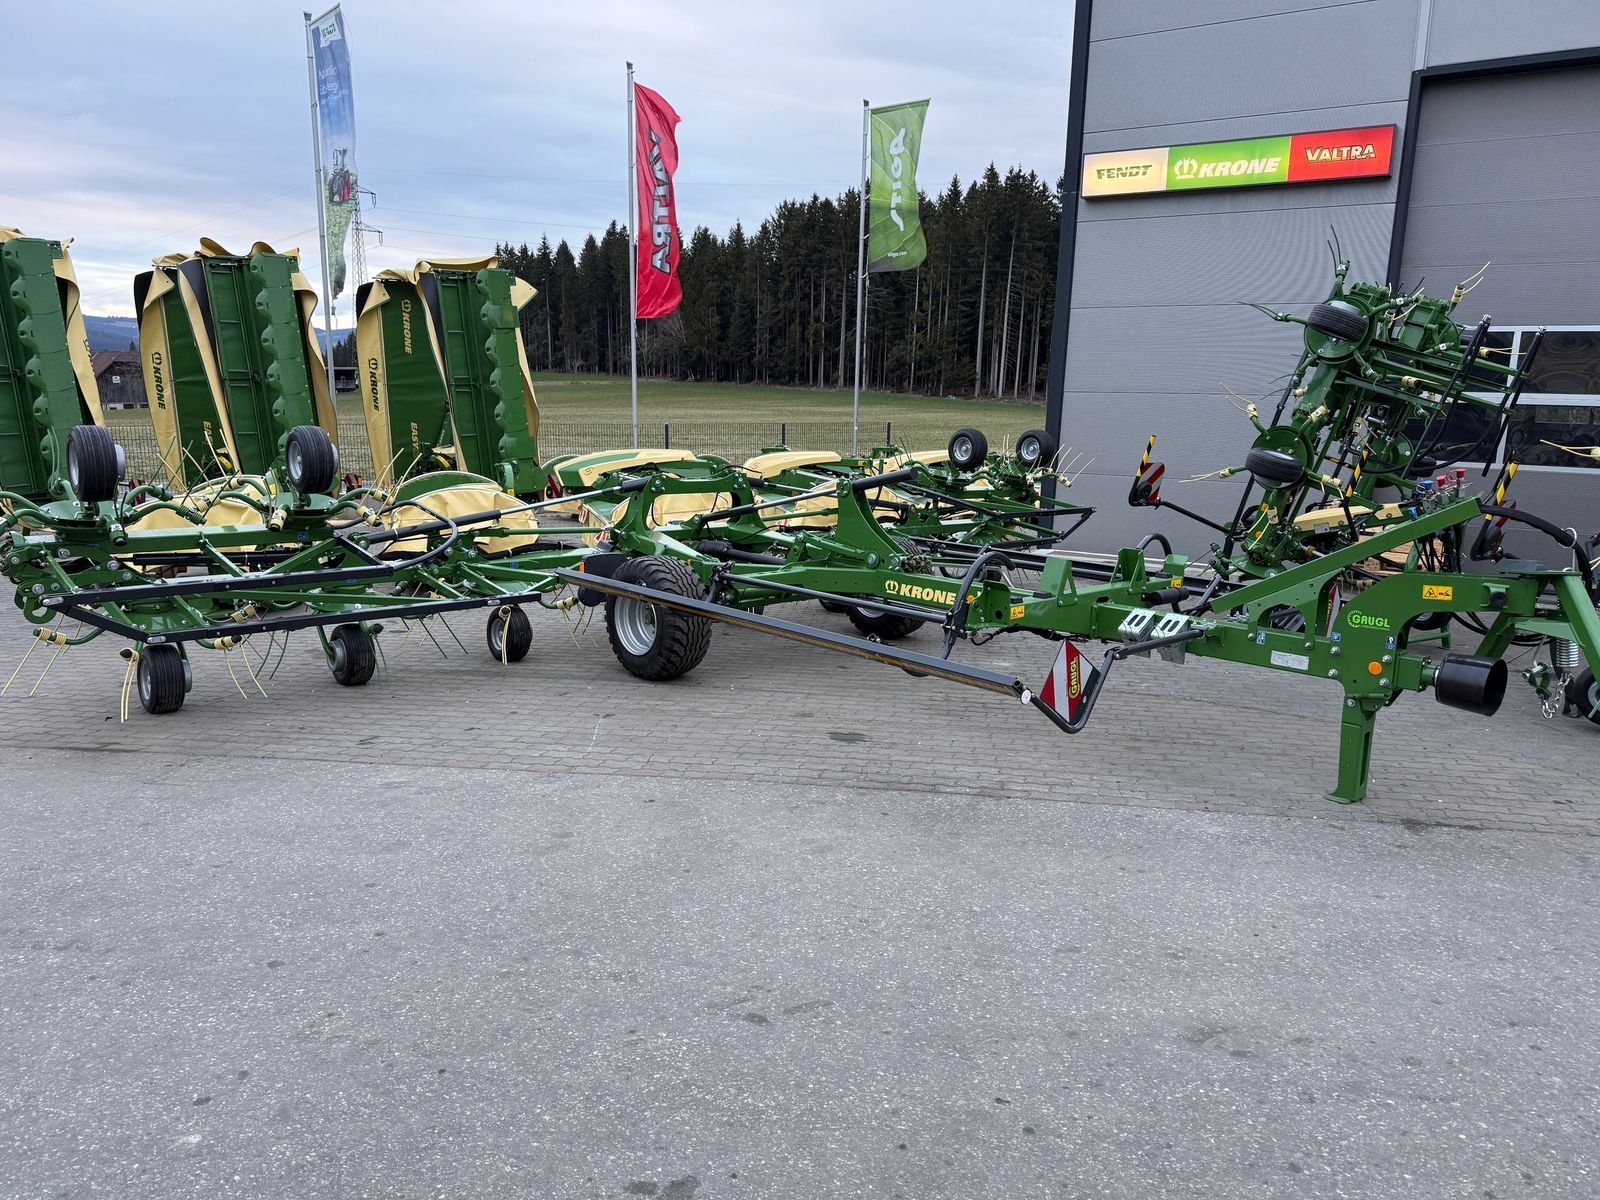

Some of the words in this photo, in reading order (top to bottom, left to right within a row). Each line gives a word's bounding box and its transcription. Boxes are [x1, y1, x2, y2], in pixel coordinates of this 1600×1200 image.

[1096, 164, 1153, 180] FENDT
[1199, 157, 1282, 178] KRONE
[1304, 143, 1376, 164] VALTRA
[889, 127, 905, 232] STIGA
[649, 128, 672, 274] VALTRA
[402, 312, 412, 355] KRONE
[153, 365, 166, 411] KRONE
[368, 371, 380, 412] KRONE
[900, 584, 957, 606] KRONE
[1352, 614, 1391, 628] GAUGL
[1070, 655, 1079, 694] GAUGL
